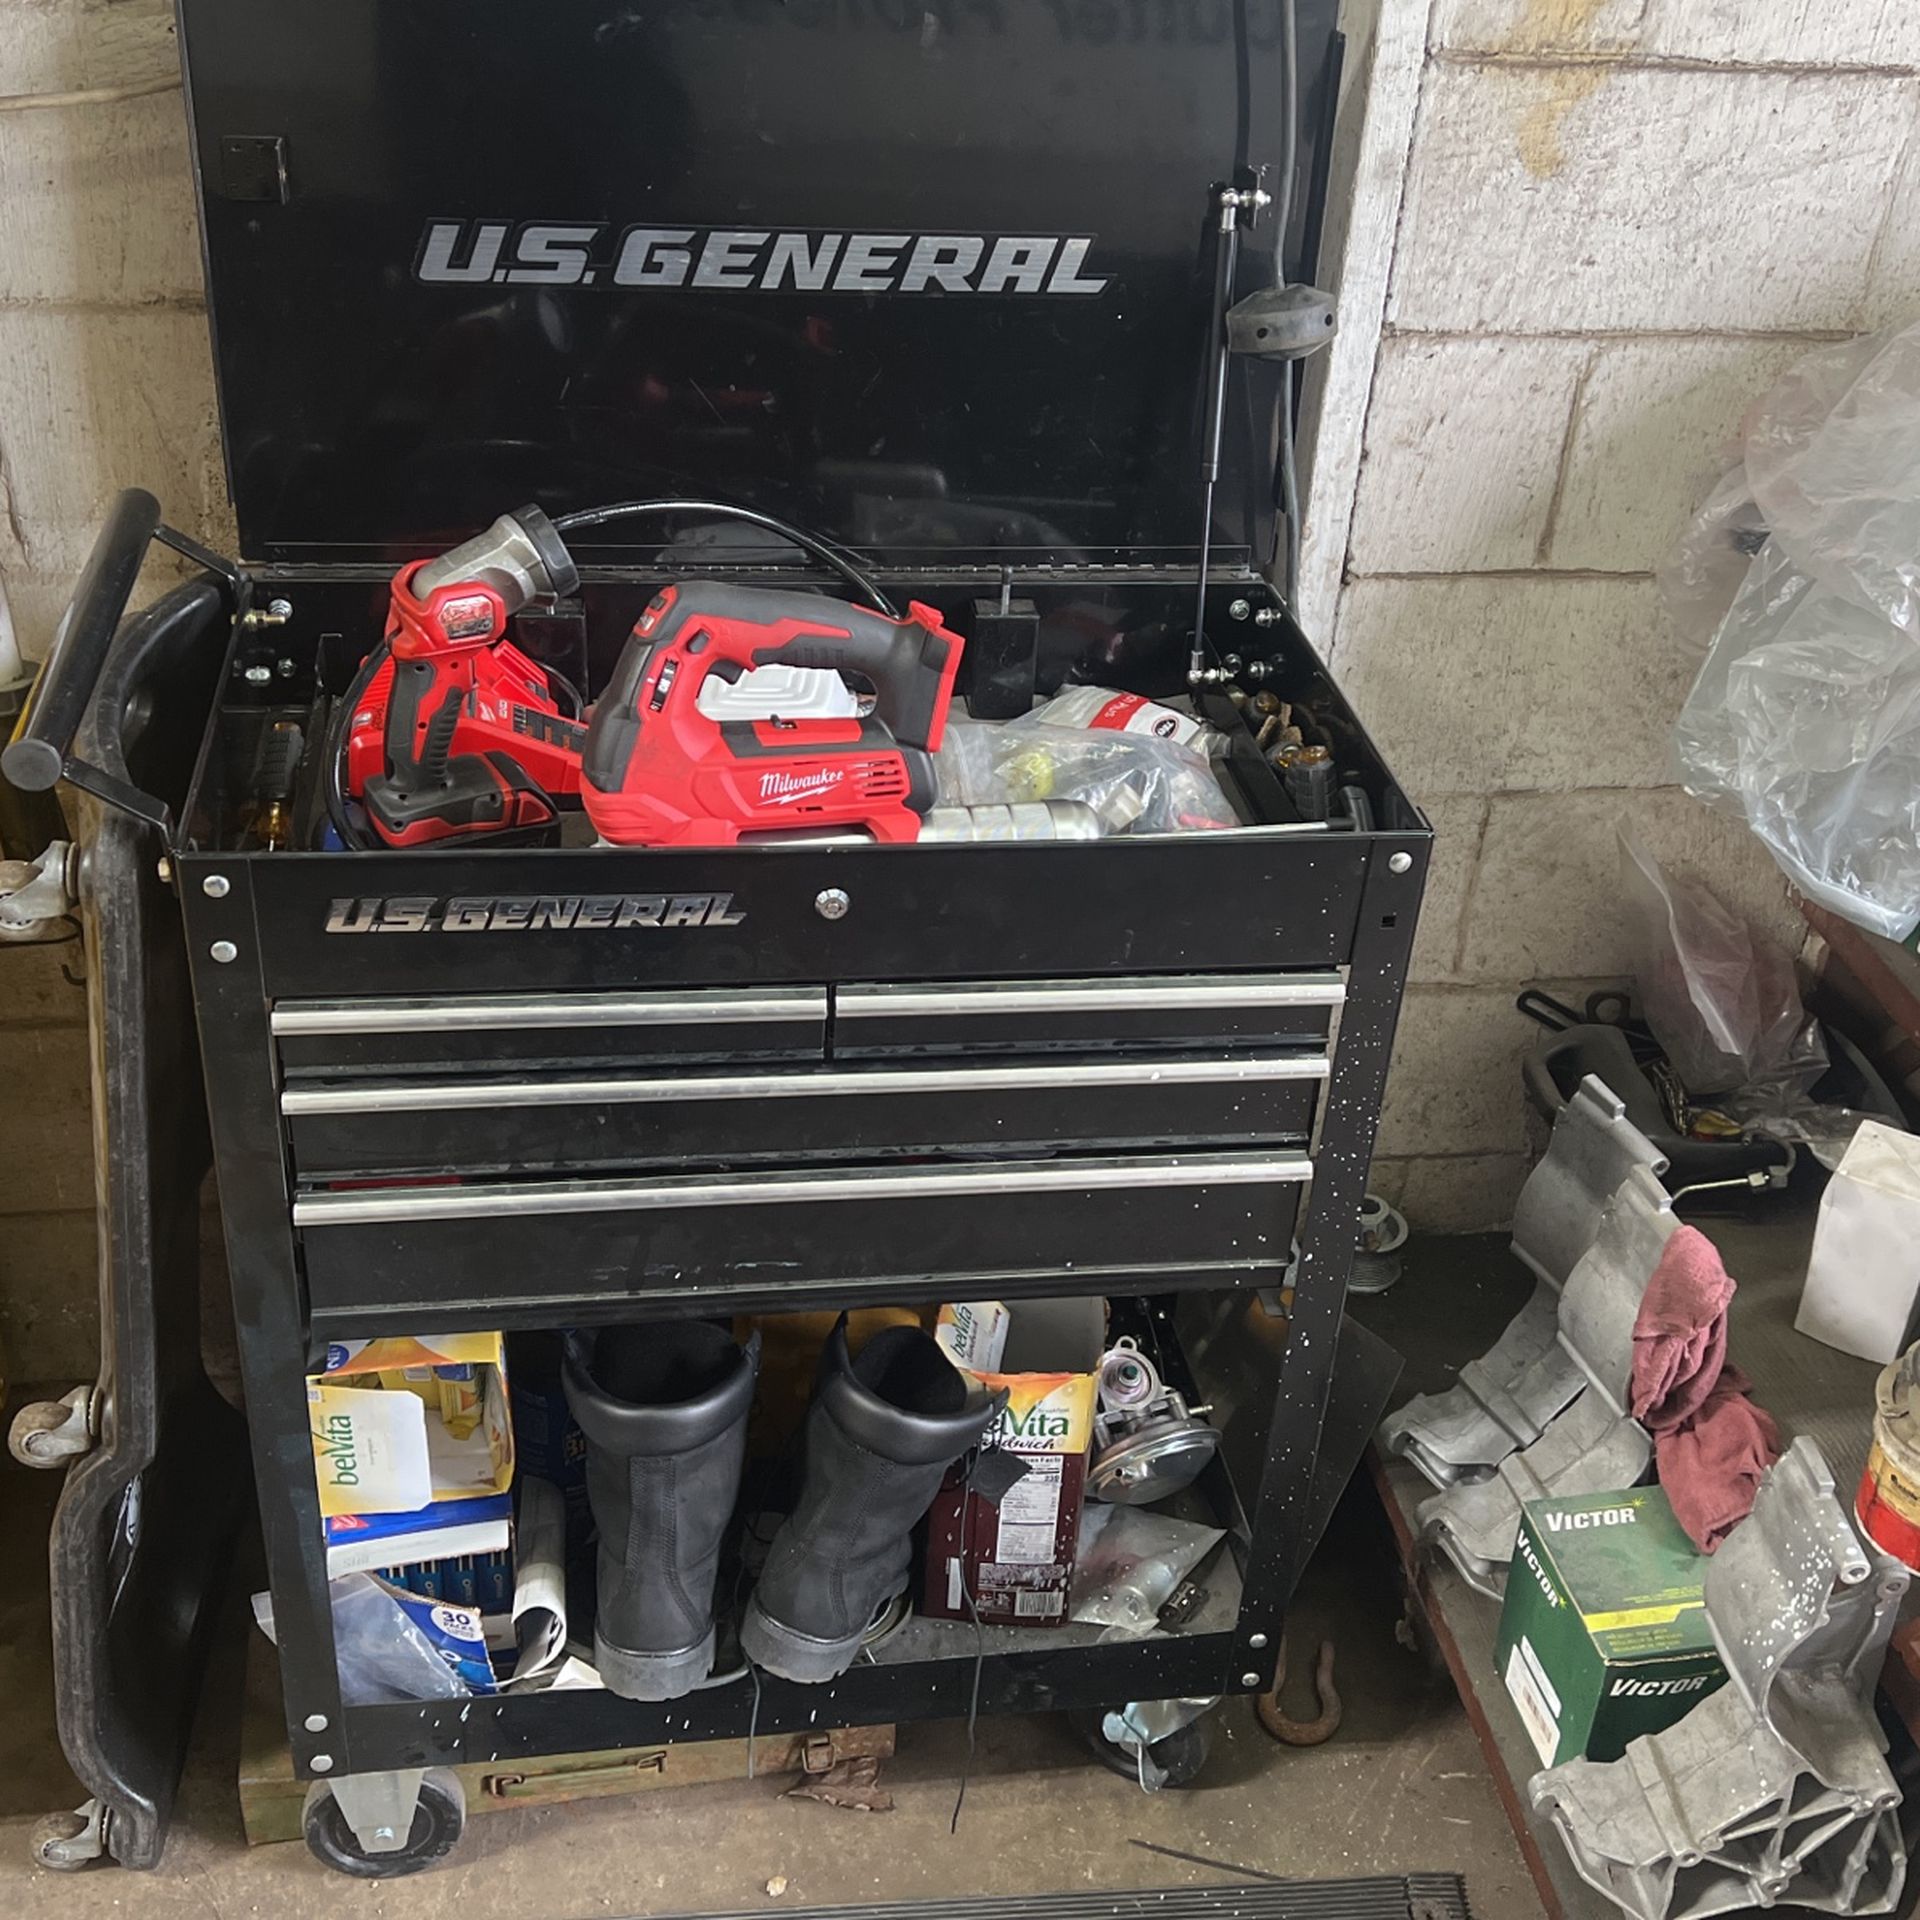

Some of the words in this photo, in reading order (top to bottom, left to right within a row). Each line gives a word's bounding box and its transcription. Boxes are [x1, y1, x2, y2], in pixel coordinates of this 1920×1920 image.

[418, 224, 596, 284] U.S.
[613, 229, 1108, 293] GENERAL
[758, 767, 844, 798] Milwaukee
[325, 897, 437, 933] U.S.
[441, 893, 748, 931] GENERAL
[950, 1305, 973, 1359] belVita
[318, 1414, 360, 1487] belVita
[1545, 1507, 1637, 1532] VICTOR
[1517, 1528, 1559, 1609] VICTOR
[442, 1610, 471, 1625] 30
[1609, 1675, 1708, 1697] VICTOR
